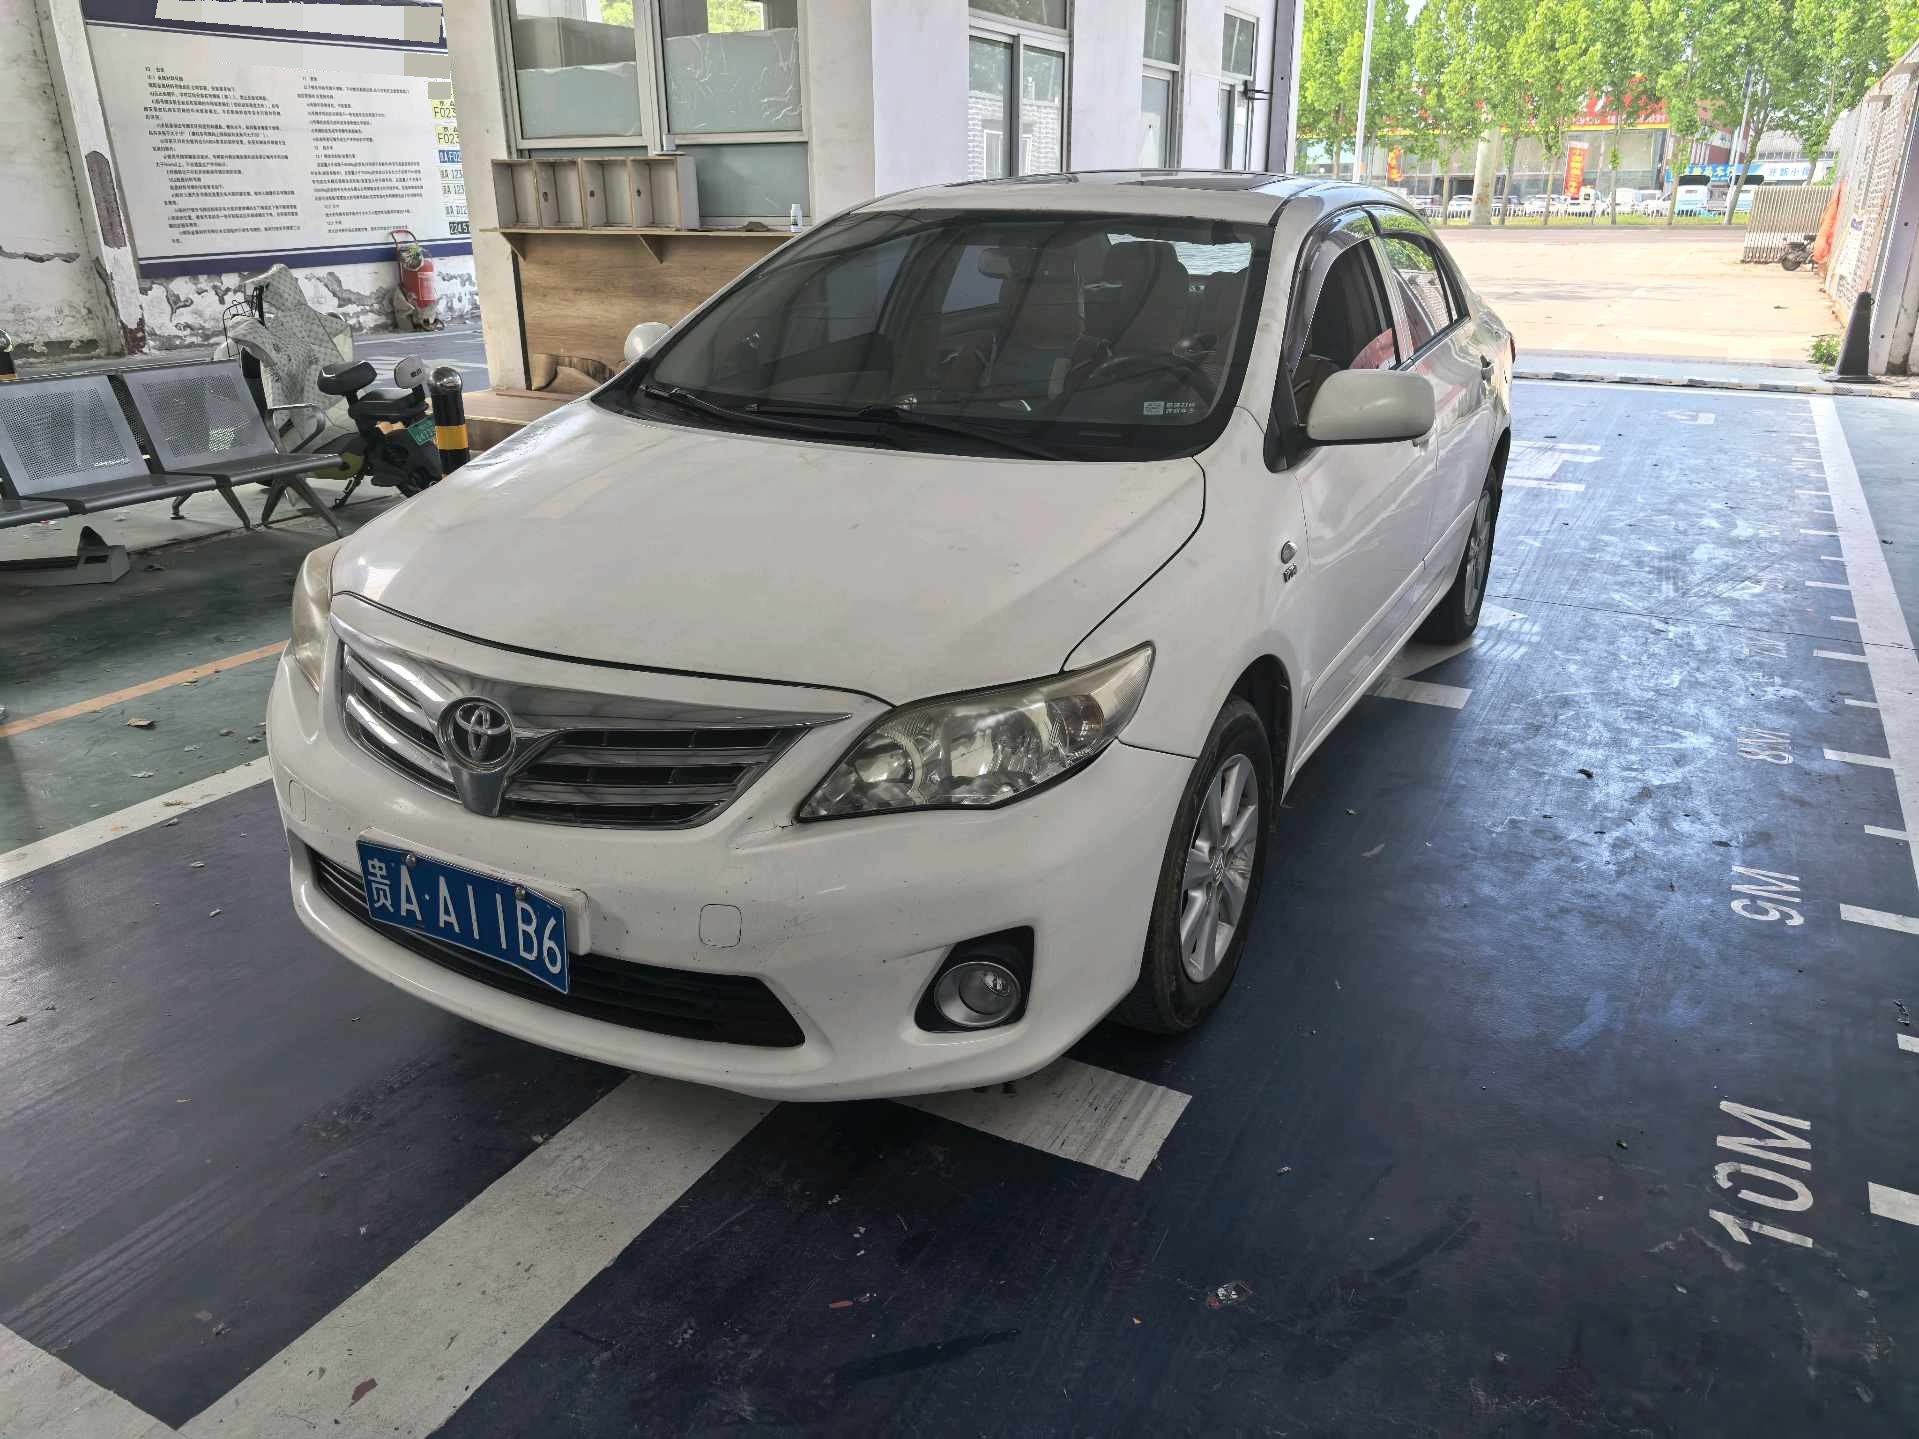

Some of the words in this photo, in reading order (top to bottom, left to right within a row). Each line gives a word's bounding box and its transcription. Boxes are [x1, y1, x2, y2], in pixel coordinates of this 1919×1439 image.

[1736, 726, 1794, 765] 8M
[1730, 864, 1805, 926] 9M
[1708, 1100, 1814, 1248] 10M
